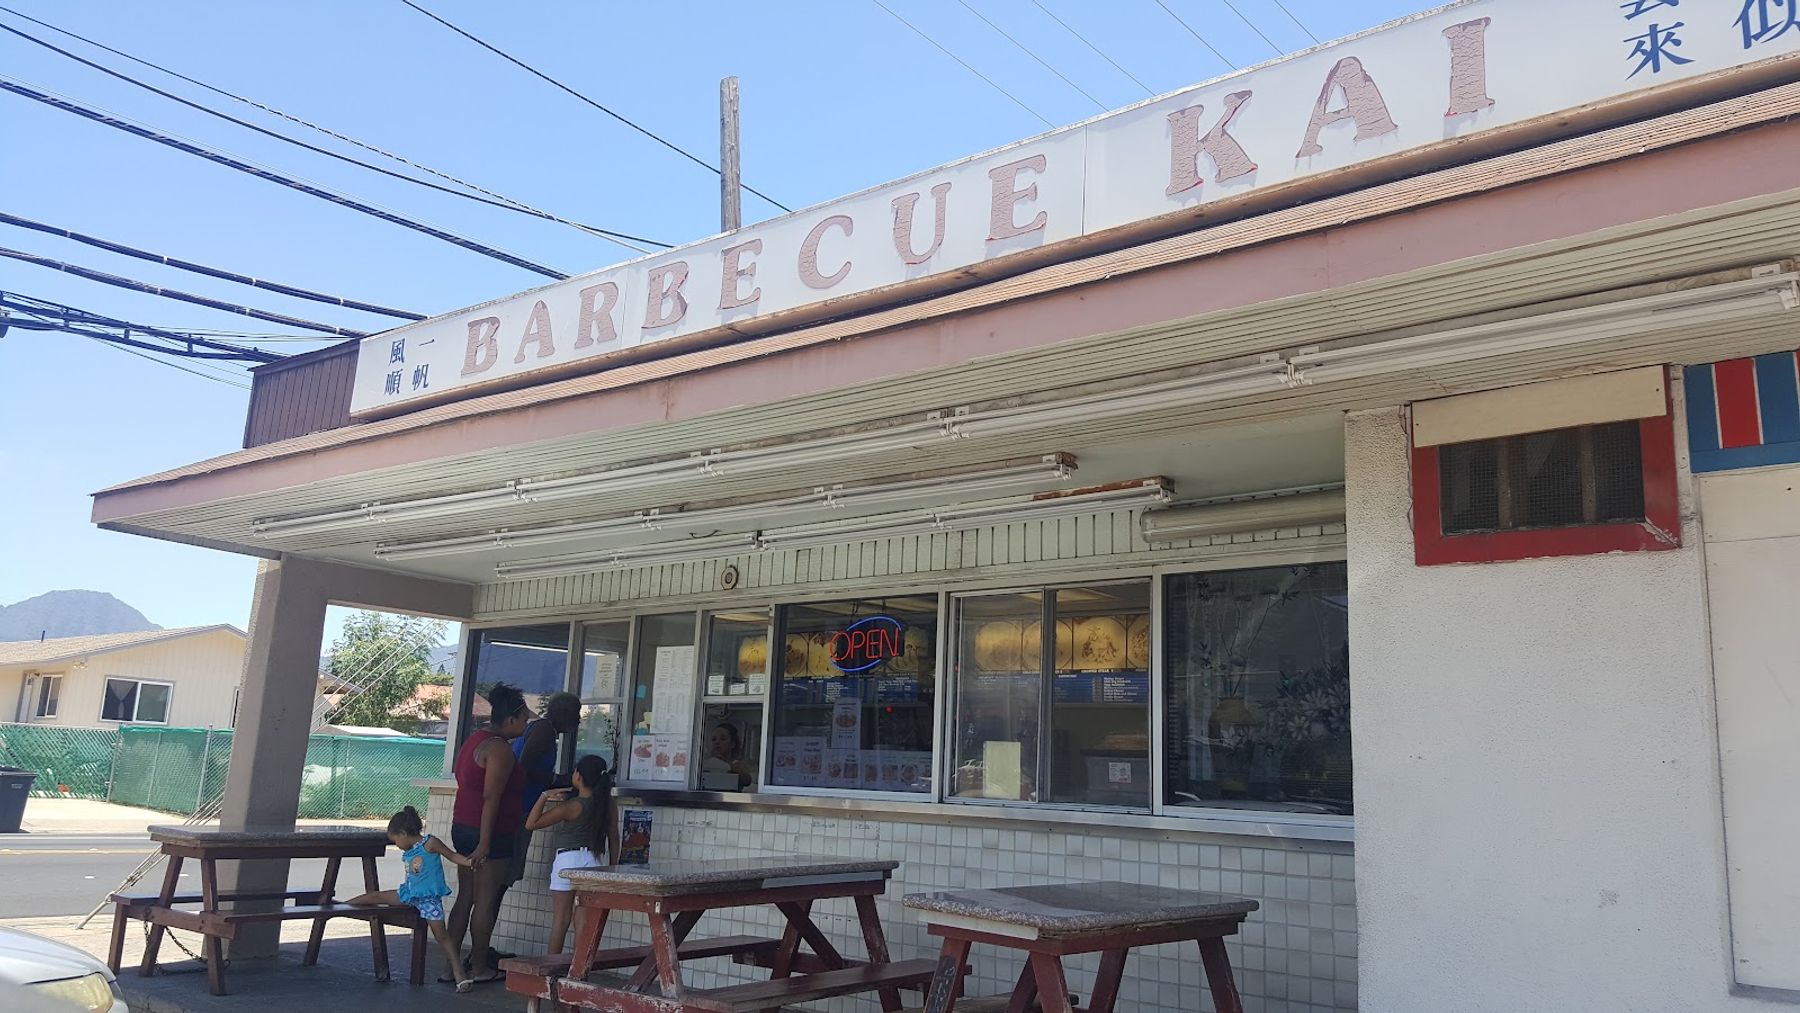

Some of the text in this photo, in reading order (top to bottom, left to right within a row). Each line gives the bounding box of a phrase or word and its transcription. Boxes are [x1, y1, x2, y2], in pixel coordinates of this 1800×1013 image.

[461, 16, 1496, 377] BARBECUE KAI
[829, 627, 900, 661] OPEN
